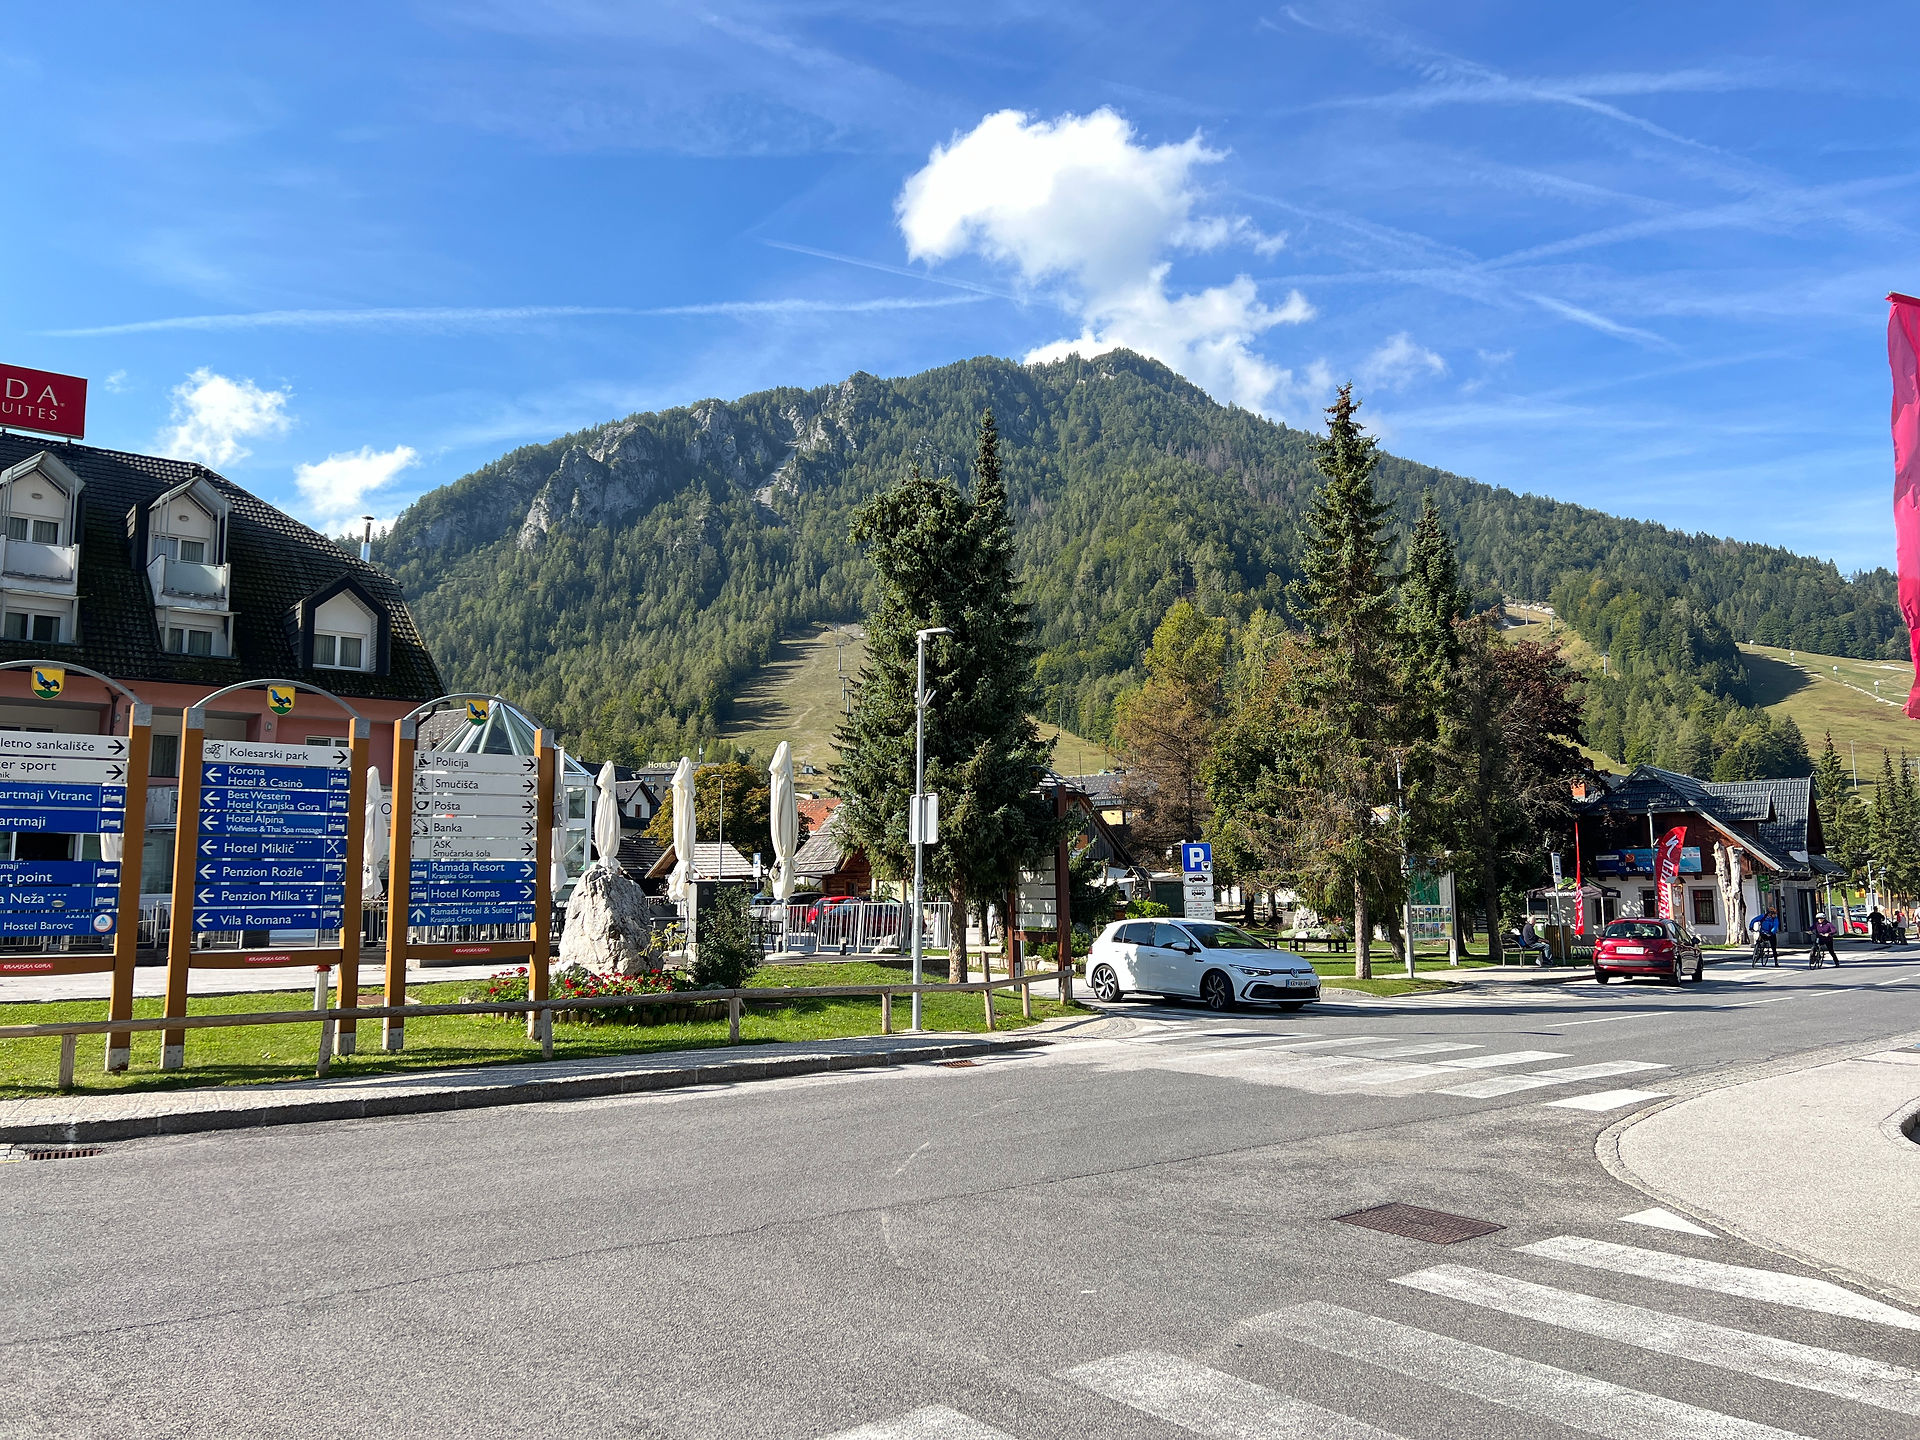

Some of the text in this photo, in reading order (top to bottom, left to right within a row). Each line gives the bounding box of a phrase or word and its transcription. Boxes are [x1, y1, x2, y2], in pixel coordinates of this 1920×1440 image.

[2, 402, 57, 420] UITES
[1, 738, 95, 752] letno sankališče
[230, 748, 309, 761] Kolesarski park
[0, 760, 56, 773] er sport
[436, 757, 469, 769] Policija
[228, 766, 265, 776] Korona
[228, 777, 256, 786] Hotel
[435, 779, 478, 789] Smučišča
[48, 790, 92, 801] Vitranc
[228, 791, 291, 800] Best Western
[256, 802, 294, 811] Kranjska
[434, 801, 460, 811] Pošta
[255, 815, 284, 825] Alpina
[434, 823, 462, 832] Banka
[224, 843, 294, 853] Hotel Miklič
[1189, 848, 1204, 868] P
[223, 867, 303, 877] Penzion Rožle
[432, 863, 505, 872] Ramada Resort
[17, 872, 52, 884] point
[10, 892, 44, 904] Neža
[221, 890, 300, 901] Penzion Milka
[431, 889, 500, 899] Hotel Kompas
[220, 915, 291, 925] Vila Romana
[4, 922, 36, 931] Hostel
